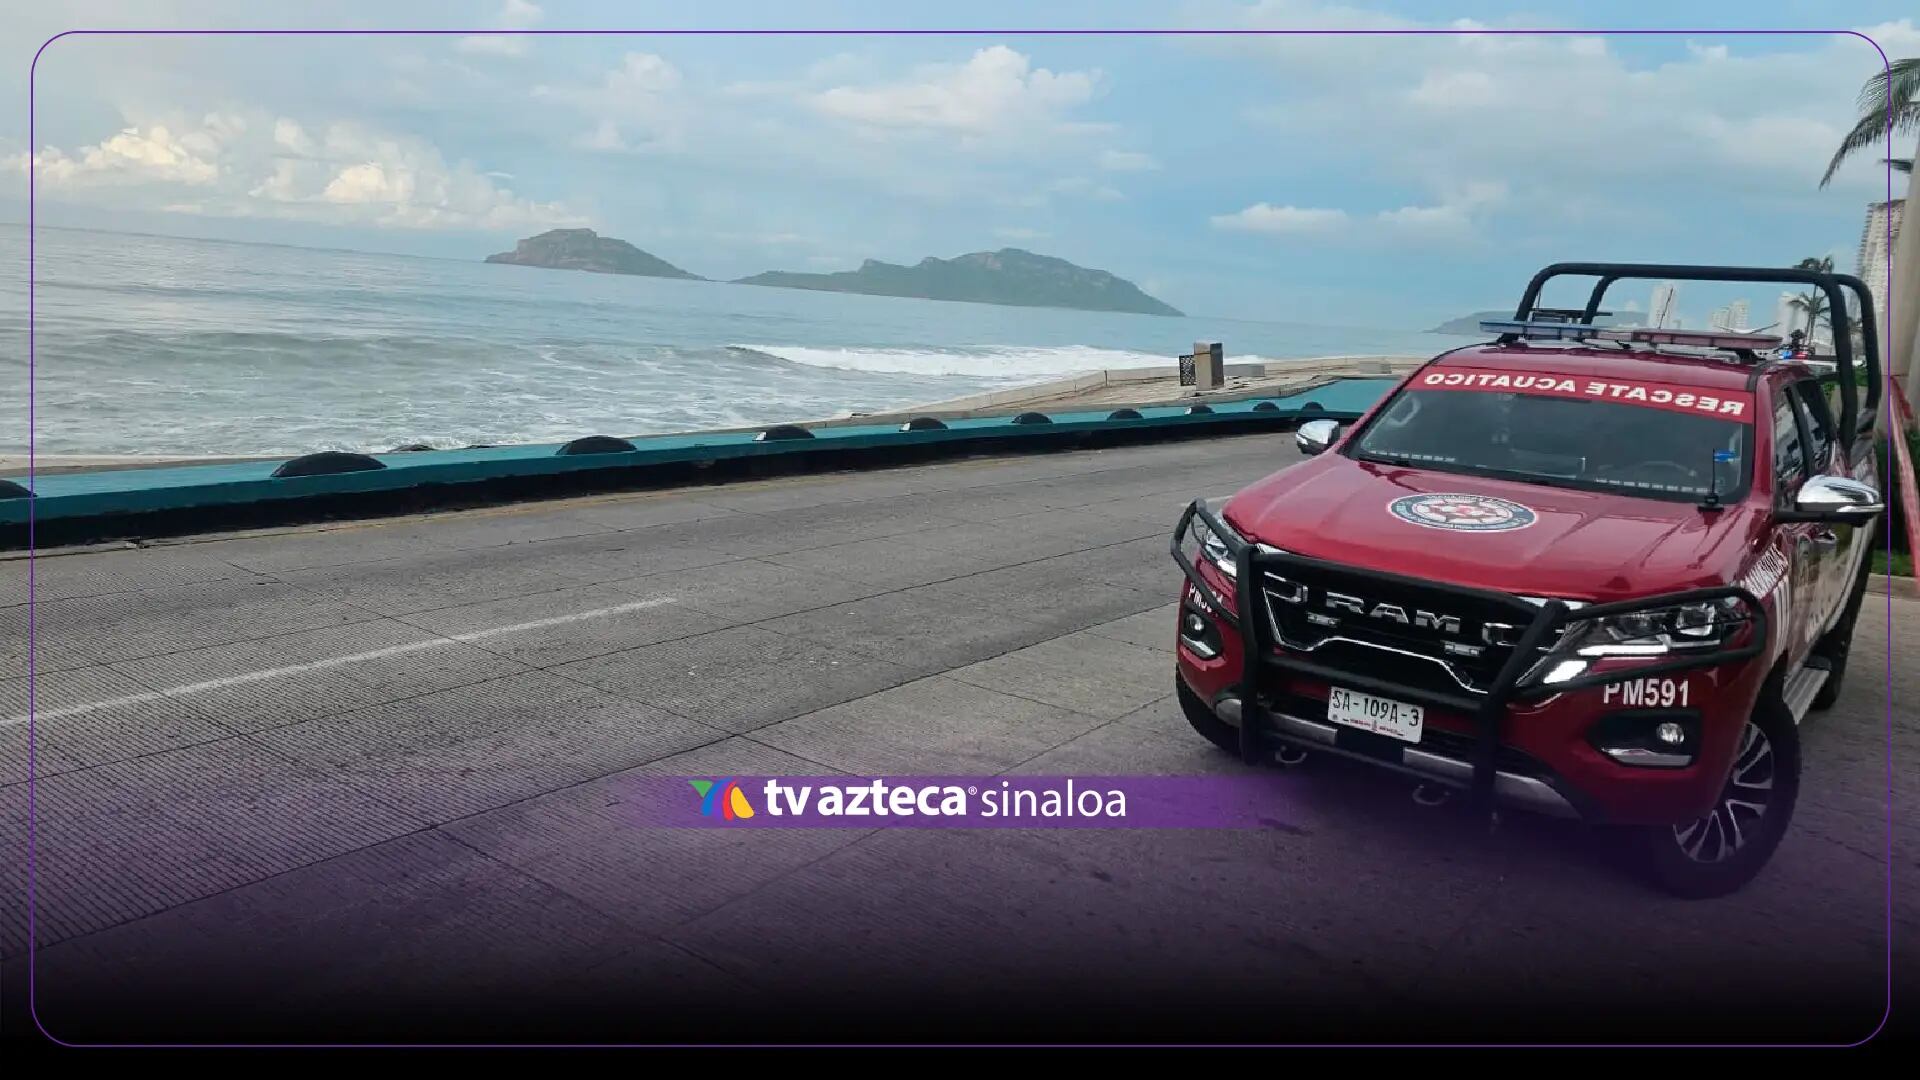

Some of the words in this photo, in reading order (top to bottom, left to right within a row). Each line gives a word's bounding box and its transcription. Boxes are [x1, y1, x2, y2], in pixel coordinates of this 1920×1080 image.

[1326, 591, 1461, 634] RAM
[1332, 690, 1420, 727] SA-109A-3
[1603, 678, 1689, 708] PM591
